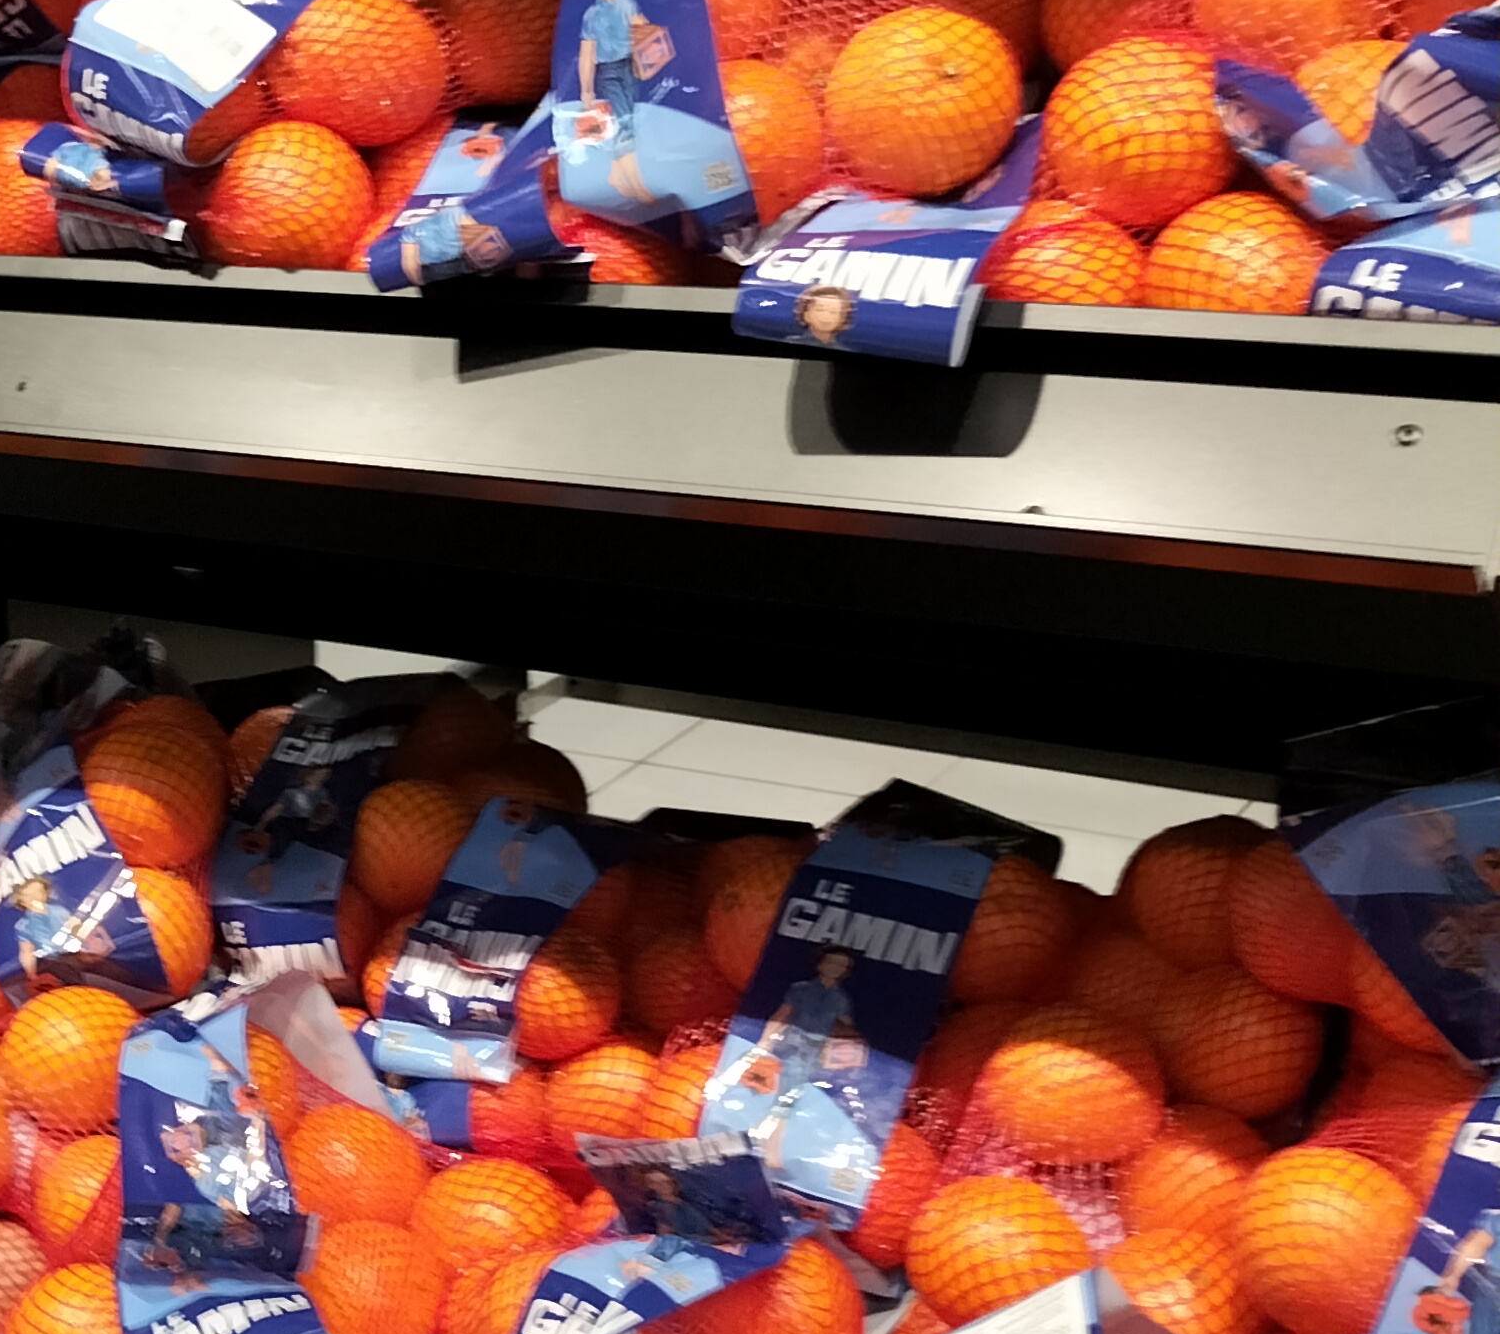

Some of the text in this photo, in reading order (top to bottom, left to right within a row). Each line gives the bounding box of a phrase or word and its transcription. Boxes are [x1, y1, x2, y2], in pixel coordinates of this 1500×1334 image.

[81, 68, 109, 100] LE
[803, 235, 854, 248] LE
[756, 248, 978, 308] GAMIN
[1349, 259, 1408, 292] LE
[814, 878, 855, 904] LE
[778, 897, 958, 975] GAMIN
